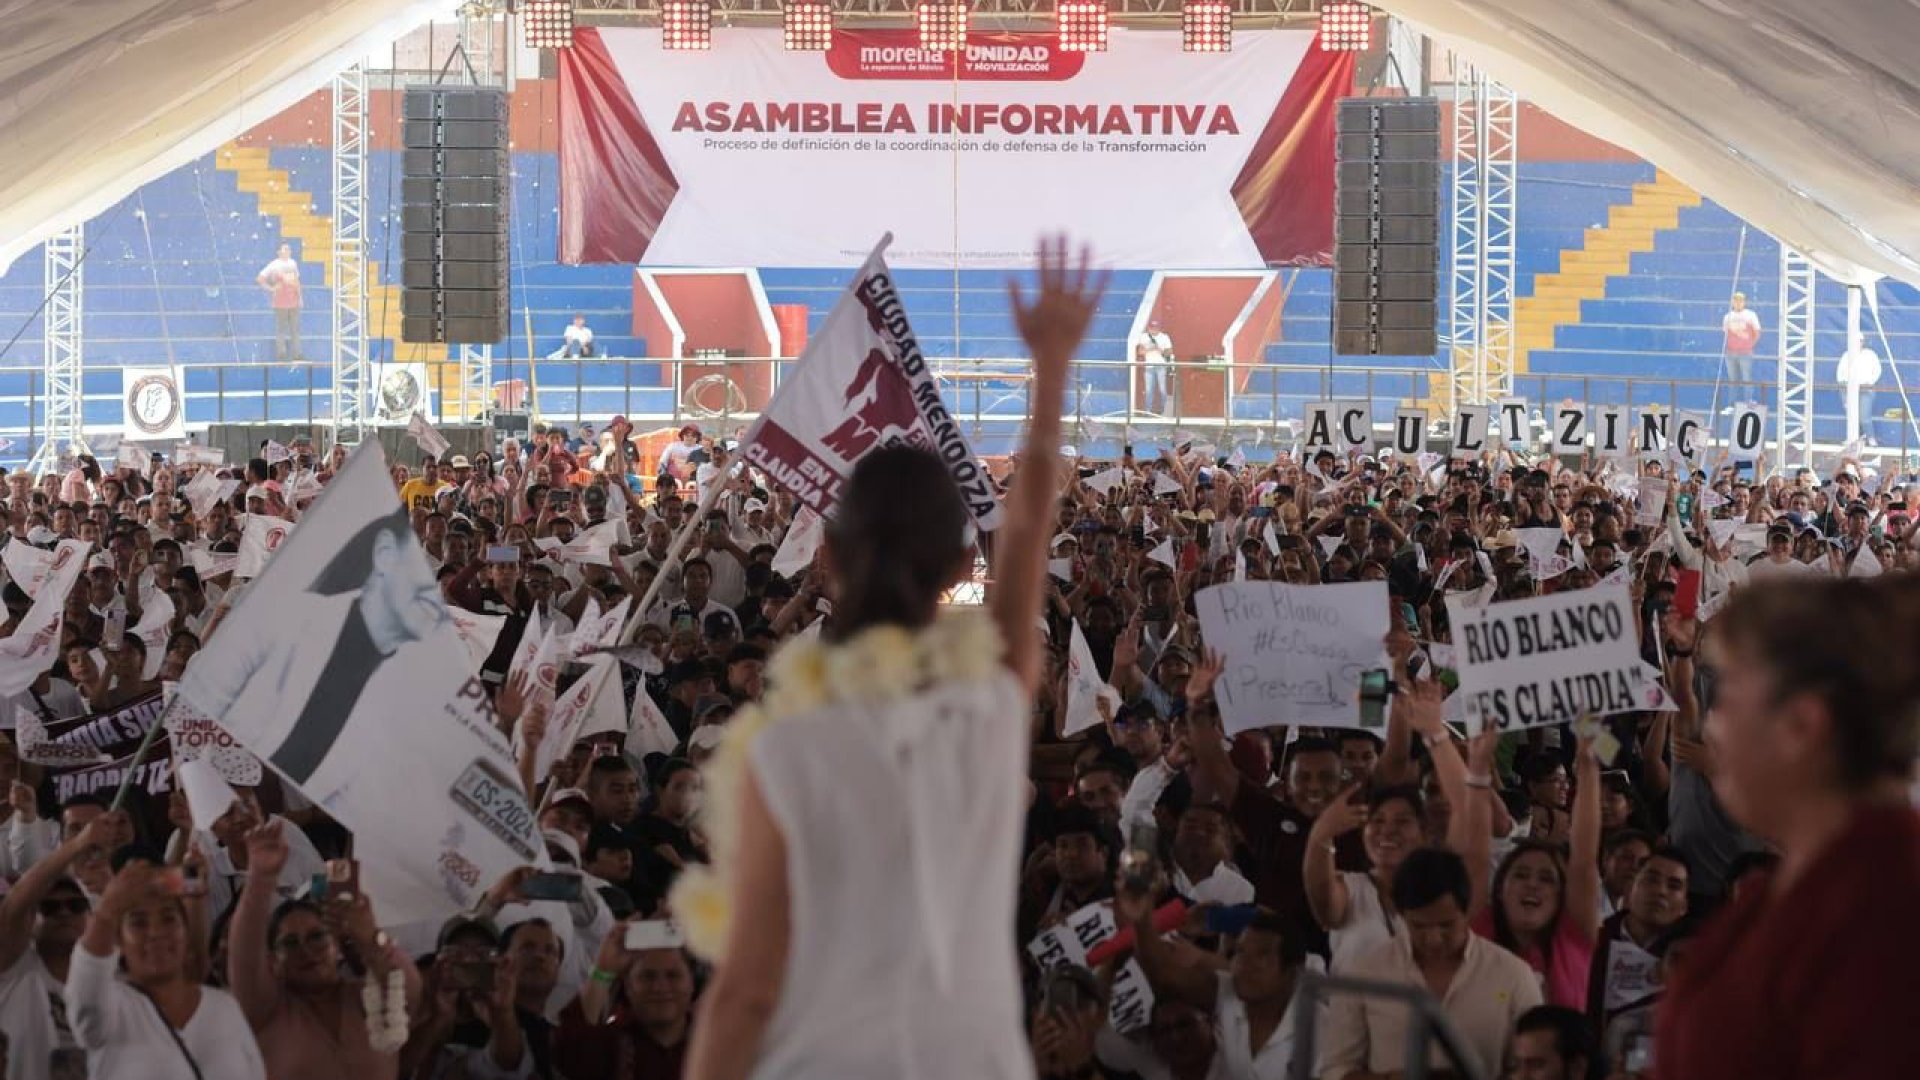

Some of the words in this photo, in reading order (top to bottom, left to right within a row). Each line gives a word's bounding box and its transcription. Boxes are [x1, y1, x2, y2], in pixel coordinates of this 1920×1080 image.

[860, 45, 944, 63] morena
[965, 45, 1049, 62] UNIDAD
[965, 63, 973, 71] Y
[974, 61, 1050, 72] MOVILIZACIÓN
[671, 101, 916, 133] ASAMBLEA
[928, 103, 1240, 135] INFORMATIVA
[704, 138, 757, 150] Proceso
[761, 138, 778, 150] de
[781, 138, 850, 151] definición
[854, 138, 871, 151] de
[875, 139, 886, 151] la
[890, 139, 979, 152] coordinación
[982, 140, 1000, 152] de
[1003, 140, 1058, 152] defensa
[1061, 140, 1079, 152] de
[1082, 141, 1094, 152] la
[1098, 140, 1208, 153] Transformación
[865, 272, 925, 378] CIUDAD
[913, 380, 997, 518] MENDOZA
[749, 443, 823, 508] CLAUDIA
[798, 456, 831, 487] EN
[1463, 608, 1510, 665] RÍO
[1513, 601, 1622, 656] BLANCO
